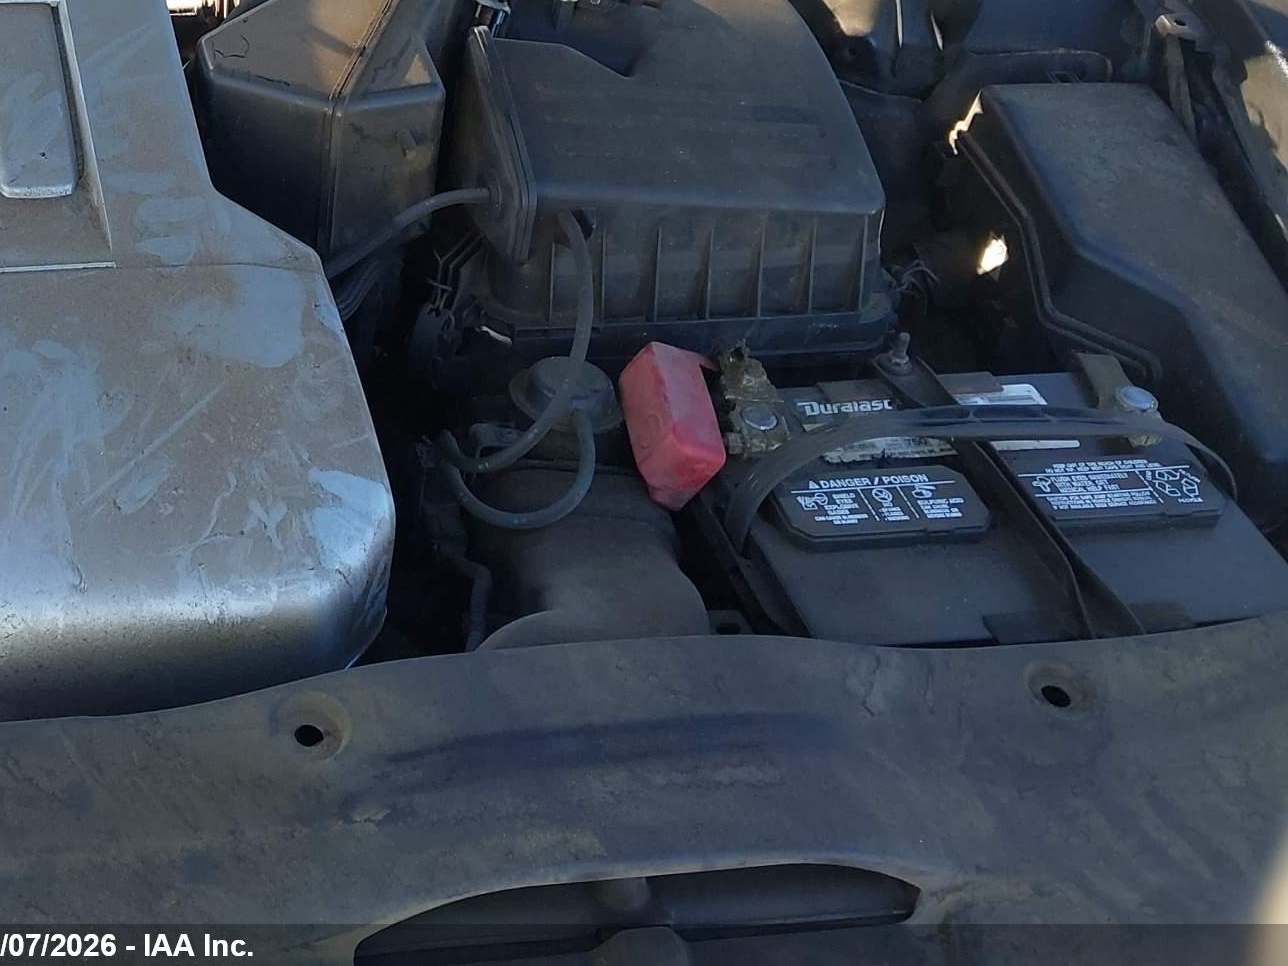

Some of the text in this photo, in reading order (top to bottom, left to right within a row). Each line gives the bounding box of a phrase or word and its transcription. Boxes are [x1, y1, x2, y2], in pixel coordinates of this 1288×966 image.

[796, 399, 893, 416] Duralast
[819, 474, 929, 488] DANGER / POISON
